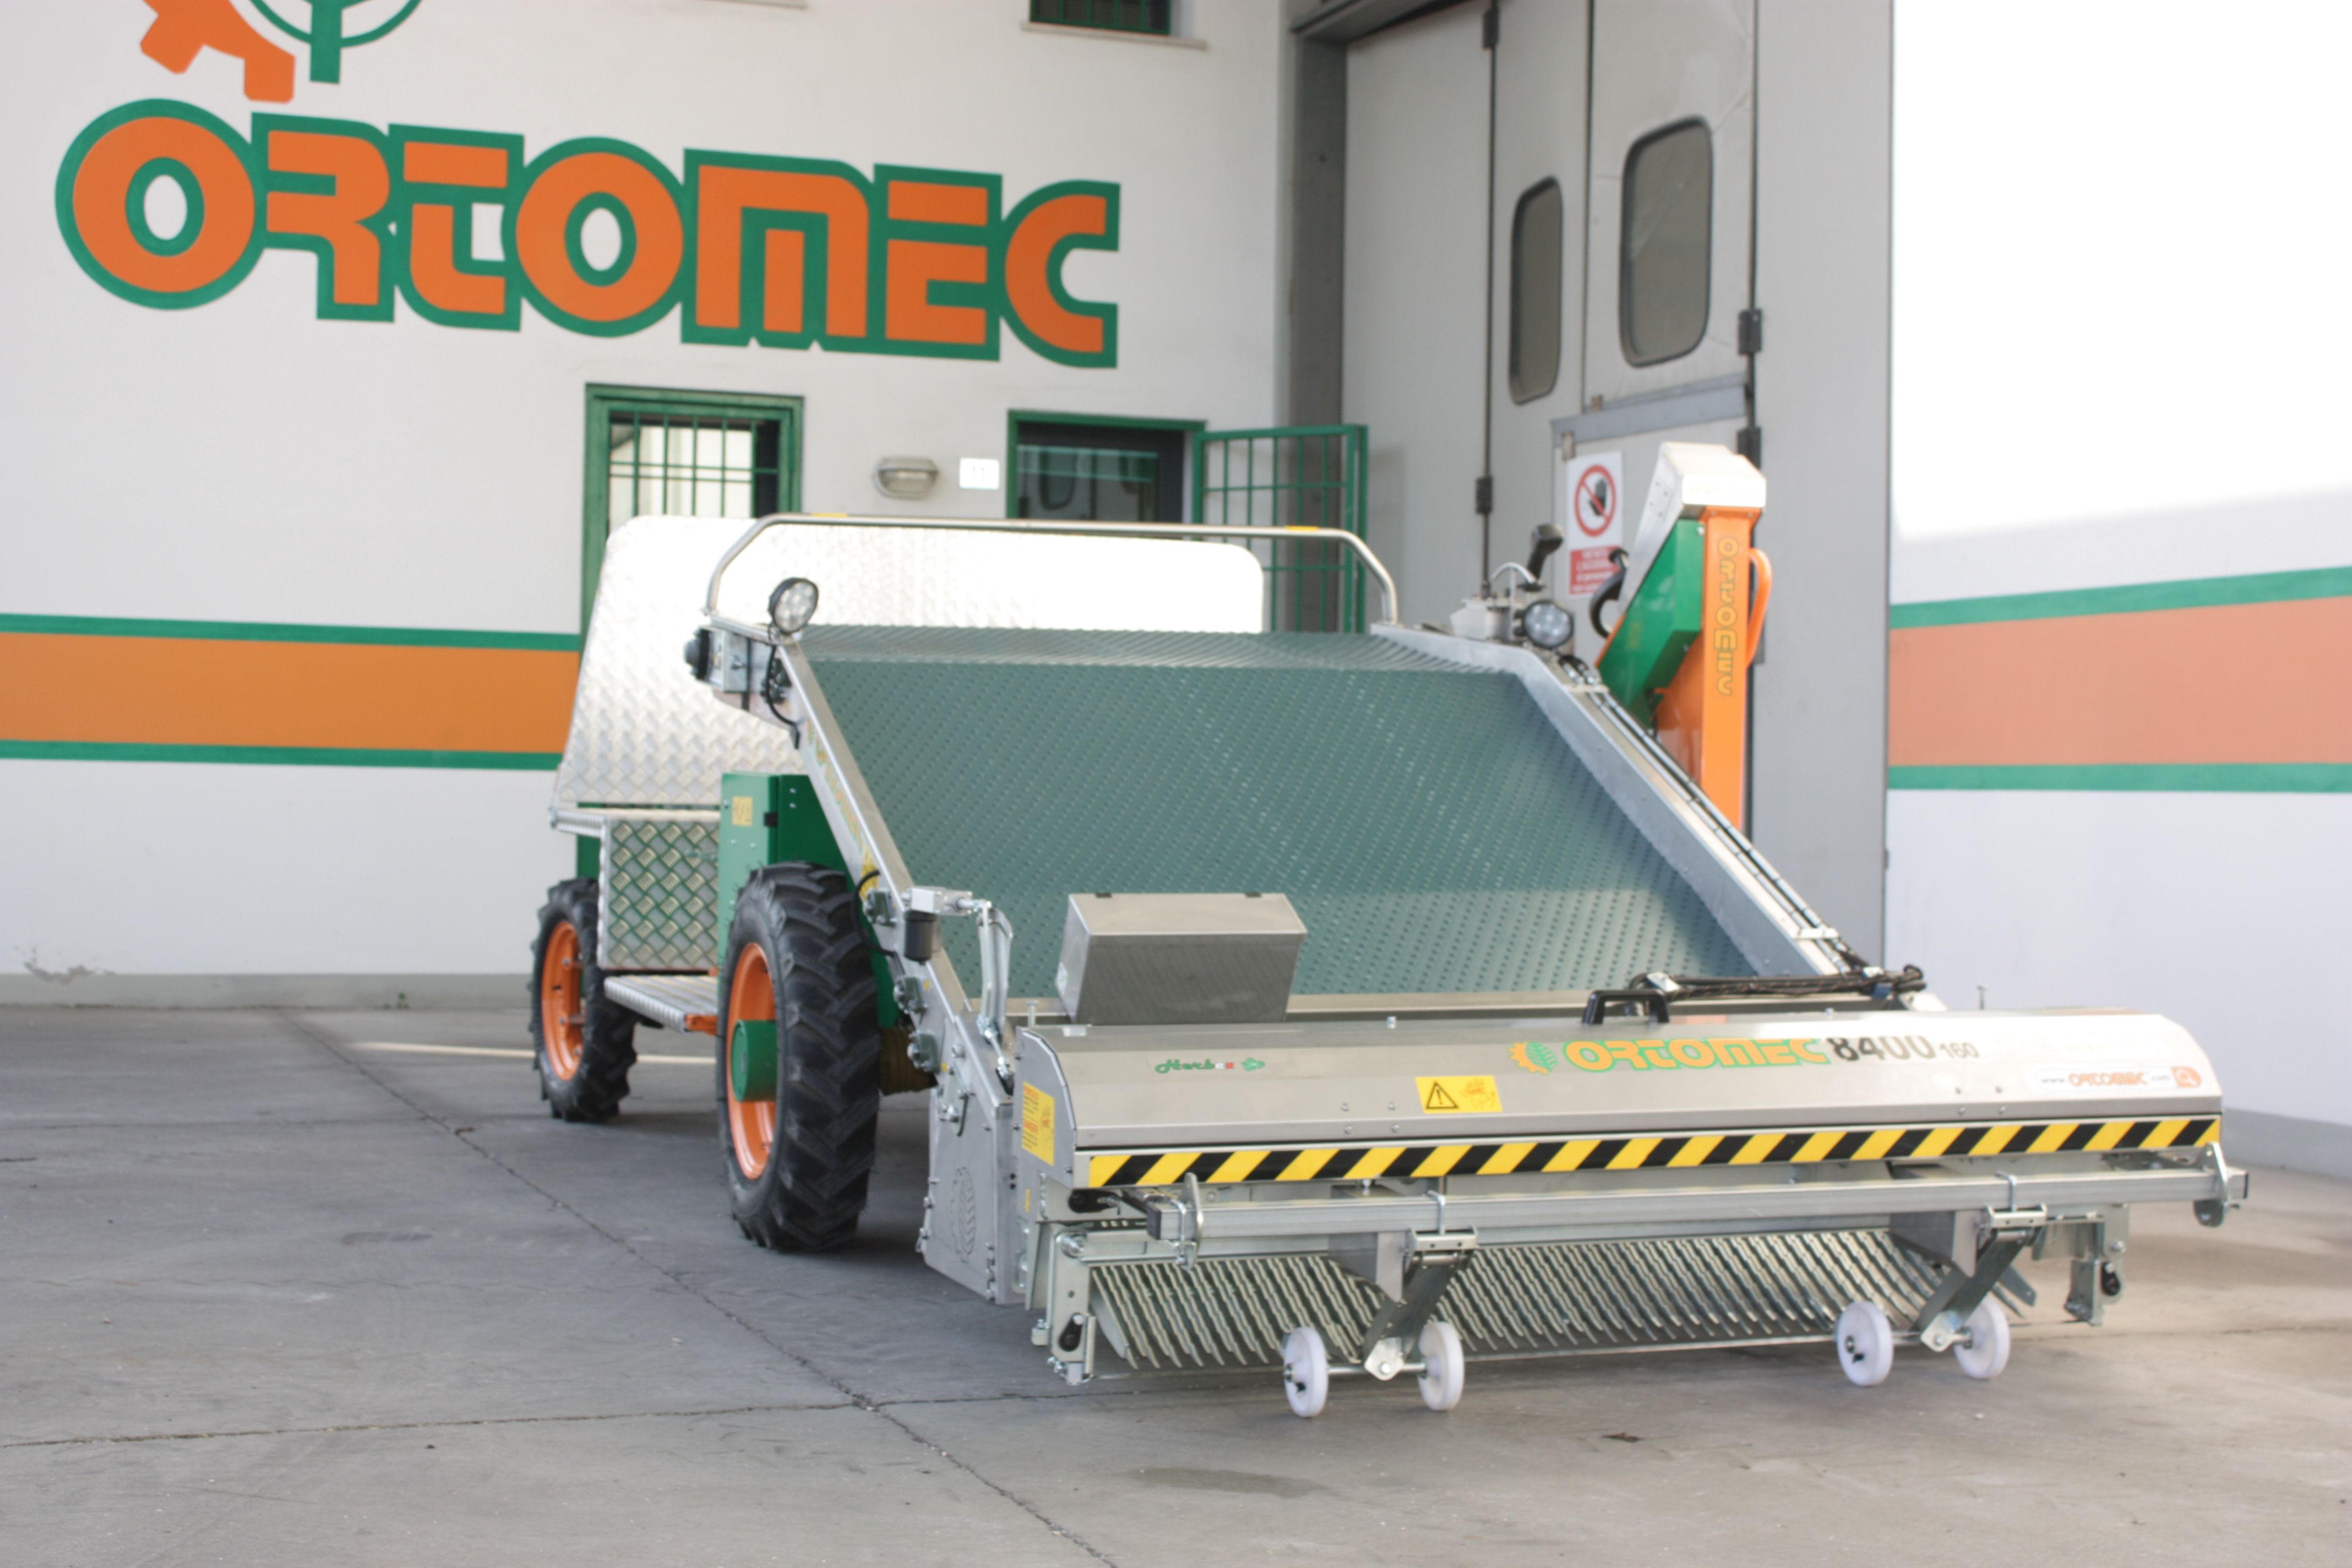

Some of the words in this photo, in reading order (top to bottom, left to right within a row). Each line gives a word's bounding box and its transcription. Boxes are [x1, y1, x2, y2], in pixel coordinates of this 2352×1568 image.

[55, 98, 1121, 369] ORTOMEC
[1714, 537, 1739, 695] ORTOMEC
[1563, 1038, 1832, 1071] ORTOMEC
[1827, 1036, 1935, 1061] 8400
[1941, 1042, 1979, 1058] 160
